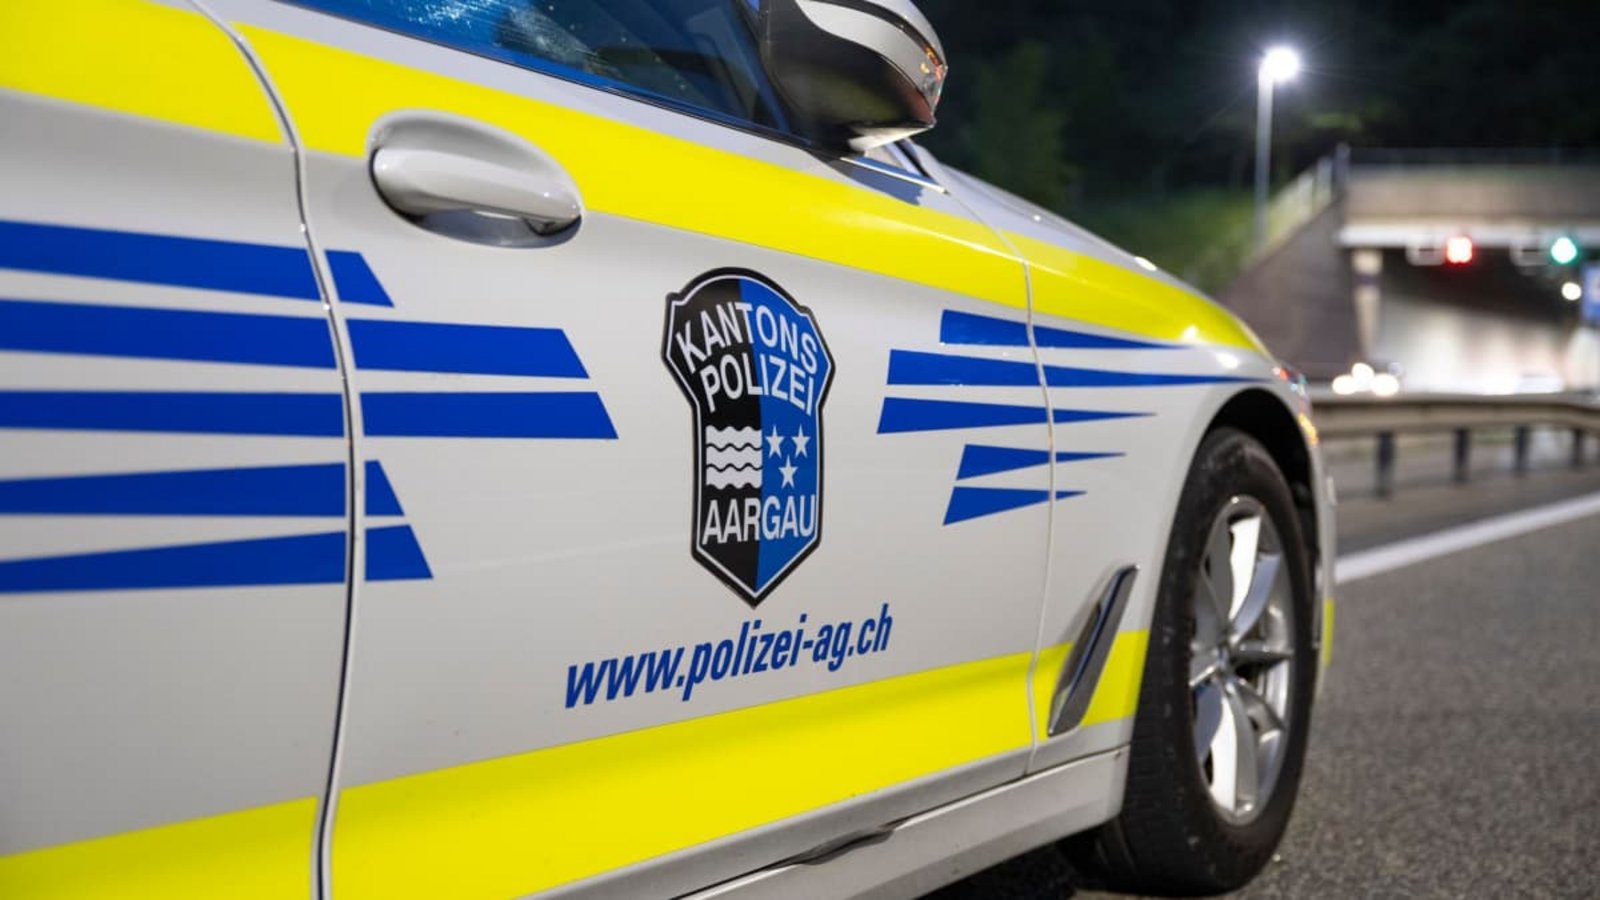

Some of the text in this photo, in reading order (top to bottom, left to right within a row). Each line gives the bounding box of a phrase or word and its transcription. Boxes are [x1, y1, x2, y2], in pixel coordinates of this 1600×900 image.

[675, 301, 818, 375] KANTONS
[700, 353, 814, 416] POLIZEI
[702, 494, 816, 545] AARGAU
[565, 602, 893, 709] www.polizei-ag.ch
